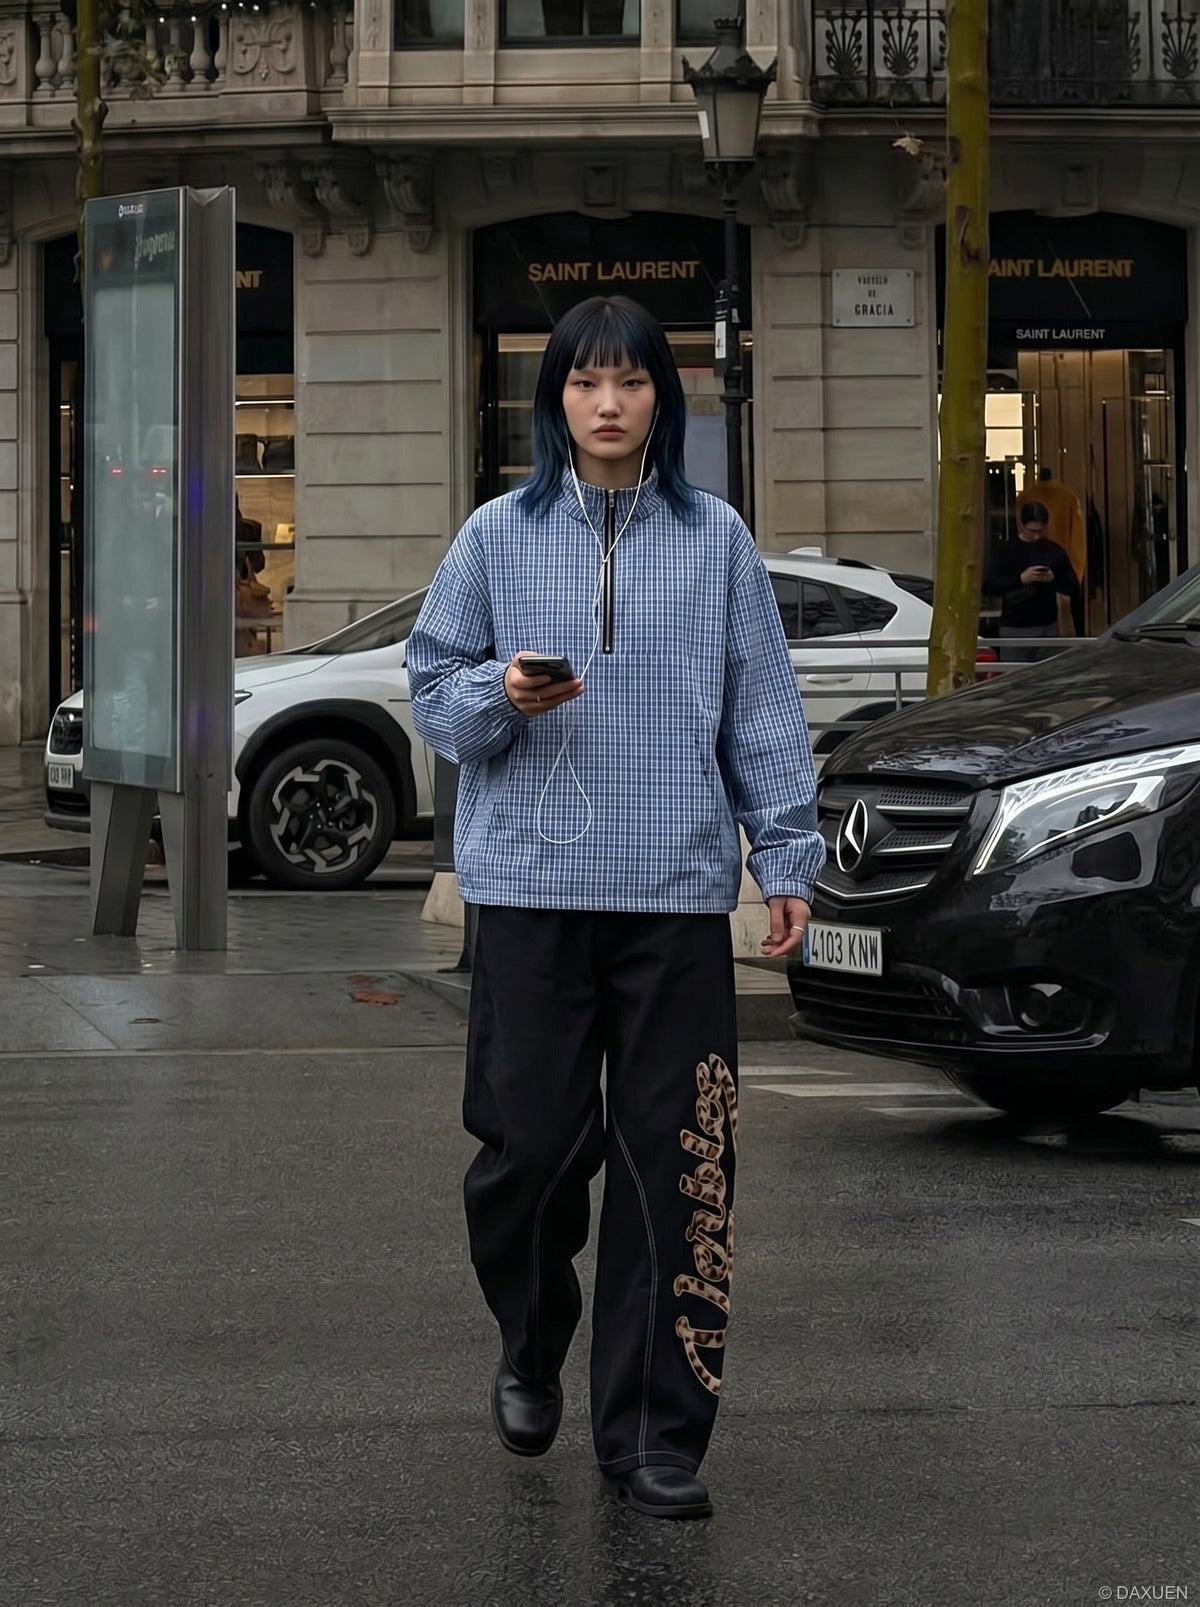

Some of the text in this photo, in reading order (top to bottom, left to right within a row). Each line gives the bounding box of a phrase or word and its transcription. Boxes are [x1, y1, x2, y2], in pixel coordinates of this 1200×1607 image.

[528, 260, 699, 281] SAINT LAURENT
[988, 259, 1134, 277] AINT LAURENT
[854, 303, 895, 316] GRACIA
[1016, 329, 1106, 340] SAINT LAURENT
[811, 928, 878, 970] 4103 KNW
